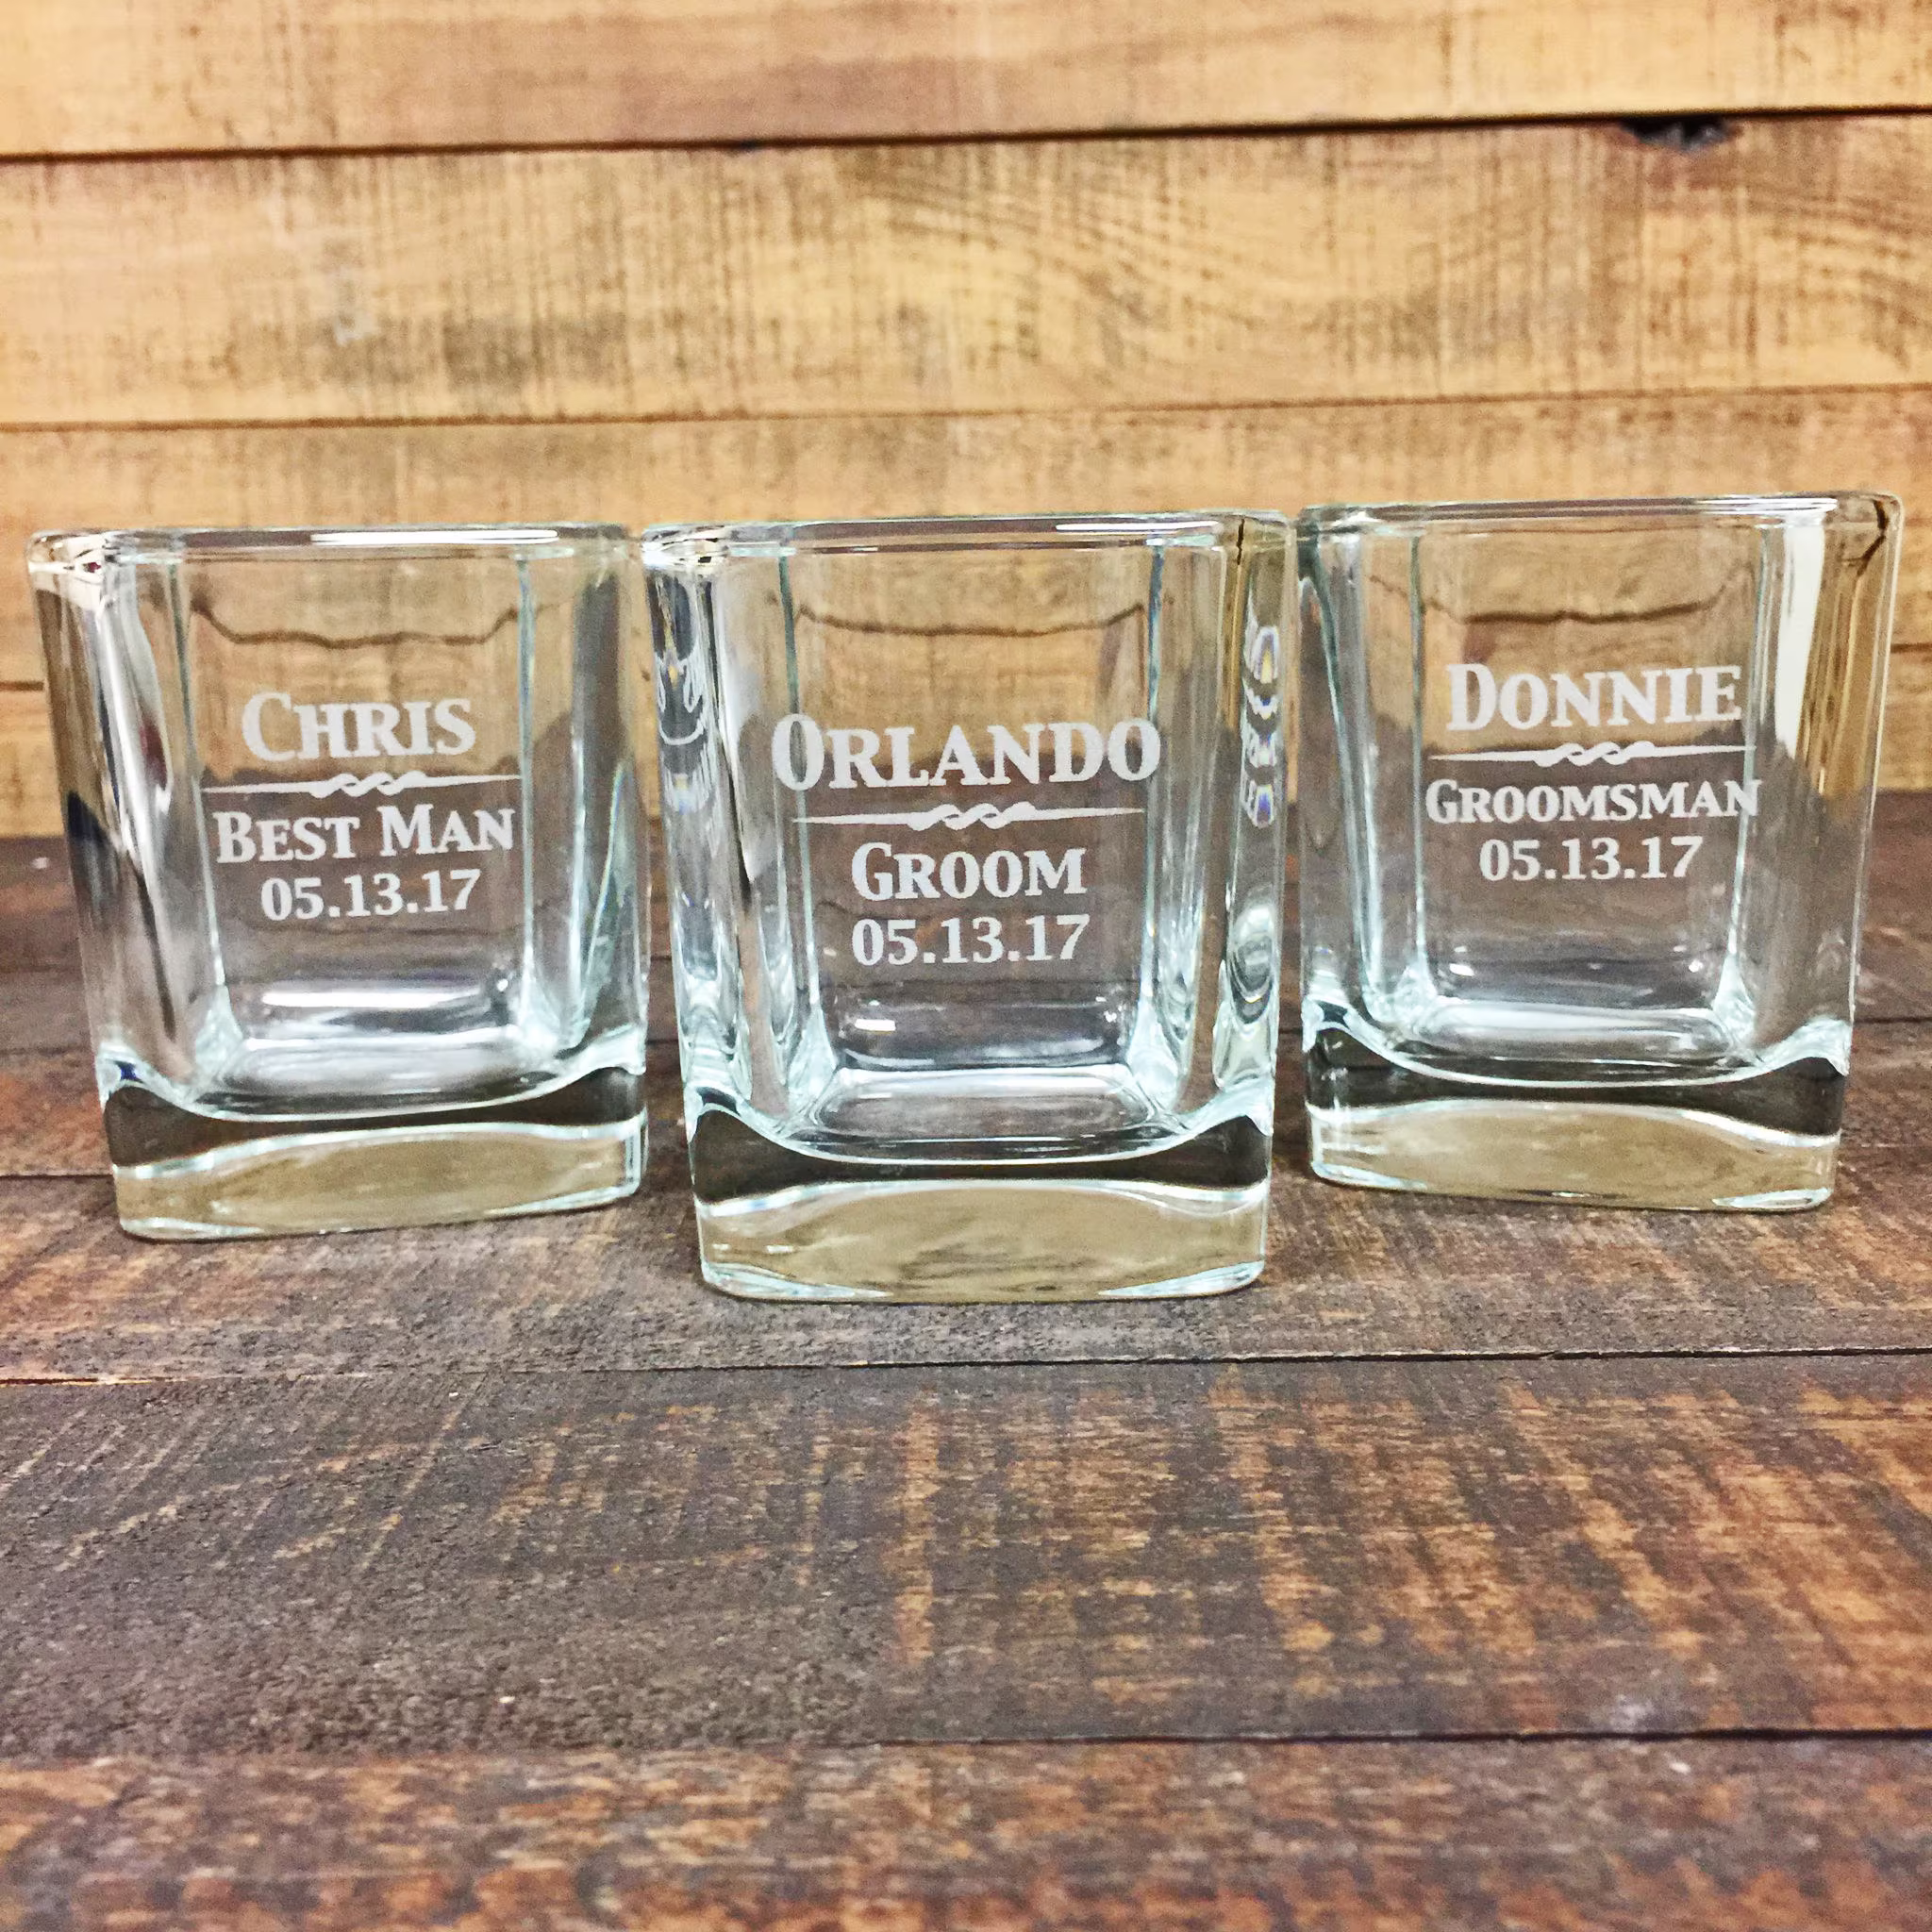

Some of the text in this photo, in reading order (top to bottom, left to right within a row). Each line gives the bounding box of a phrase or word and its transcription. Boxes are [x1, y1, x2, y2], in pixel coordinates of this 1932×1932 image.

[242, 691, 476, 761] CHRIS
[1446, 663, 1741, 731] DONNIE
[772, 713, 1160, 791] ORLANDO
[1425, 778, 1762, 824] GROOMSMAN
[212, 804, 515, 863] BEST MAN
[1479, 836, 1703, 882] 05.13.17
[260, 869, 481, 921] 05.13.17
[851, 841, 1087, 901] GROOM
[852, 913, 1091, 966] 05.13.17
